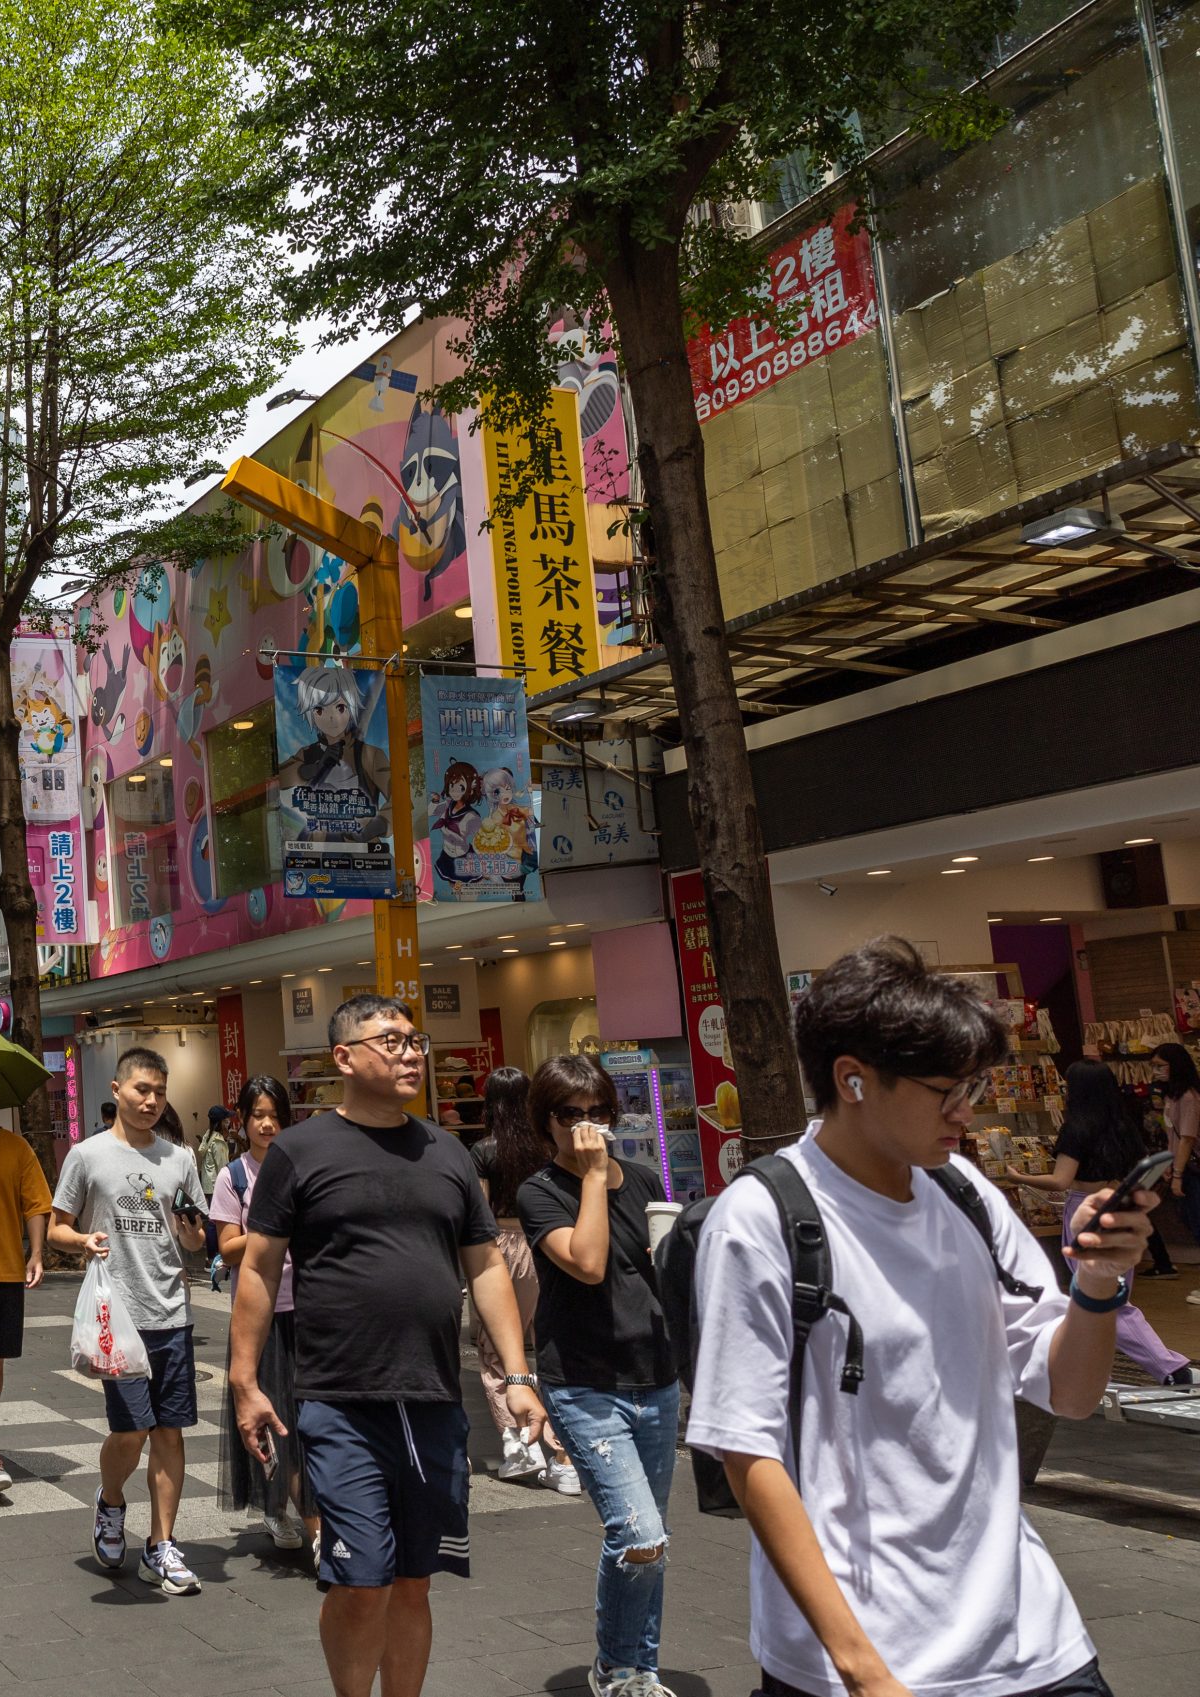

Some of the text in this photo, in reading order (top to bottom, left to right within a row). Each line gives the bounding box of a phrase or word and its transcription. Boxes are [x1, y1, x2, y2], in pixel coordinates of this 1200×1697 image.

[496, 441, 513, 500] LITTL
[503, 509, 523, 616] SINGAPORE
[439, 708, 517, 738] 西門町
[546, 769, 583, 791] 高美
[593, 822, 630, 845] 高美
[49, 832, 75, 931] 請上2樓
[396, 938, 412, 957] H
[296, 990, 308, 998] SALE
[394, 980, 419, 1000] 35
[432, 1000, 452, 1010] 50%
[115, 1219, 163, 1234] SURFER
